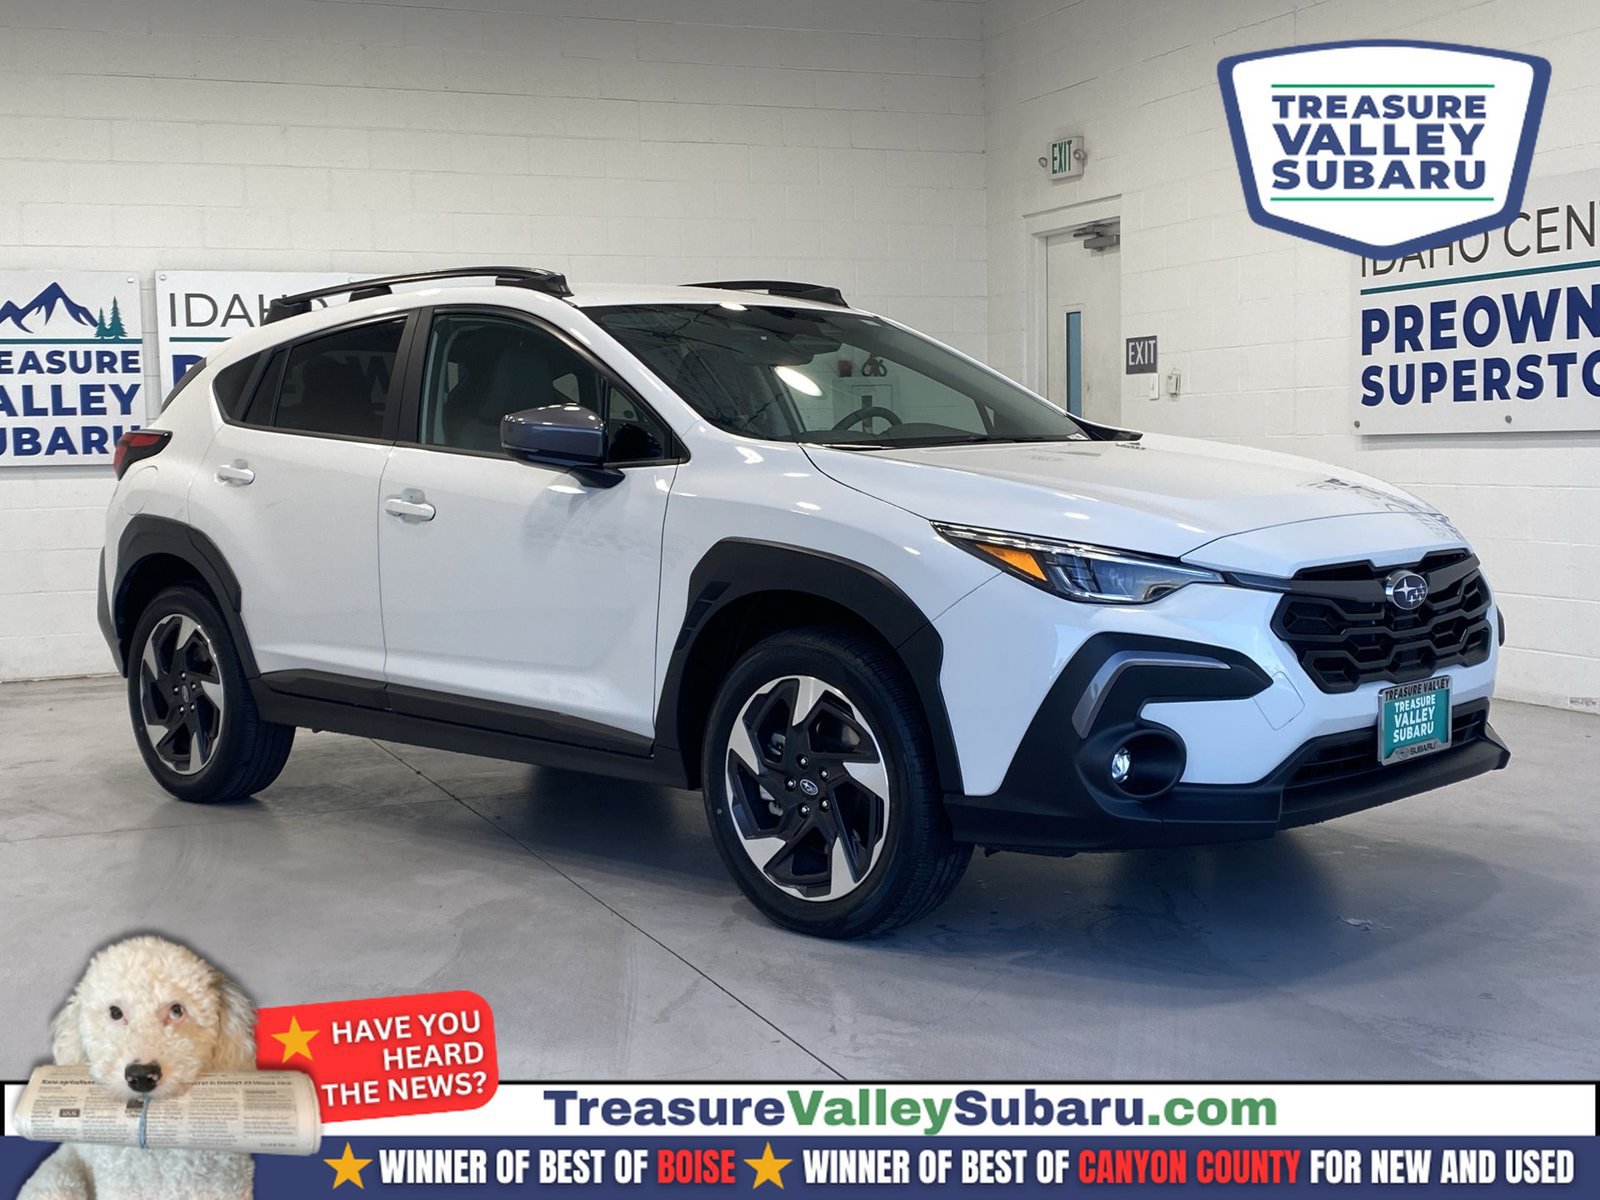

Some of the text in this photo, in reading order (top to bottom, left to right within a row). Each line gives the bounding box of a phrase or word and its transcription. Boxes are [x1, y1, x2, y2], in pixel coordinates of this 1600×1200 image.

[1051, 140, 1073, 174] EXIT
[1503, 200, 1600, 258] CEN
[169, 292, 329, 328] IDA
[1361, 284, 1600, 356] PREOWN
[1128, 339, 1157, 366] EXIT
[1385, 677, 1450, 702] TREASURE VALLEY
[1394, 693, 1436, 713] TREASURE
[1394, 705, 1436, 729] VALLEY
[1393, 721, 1435, 743] SUBARU
[1409, 742, 1437, 755] SUBARU
